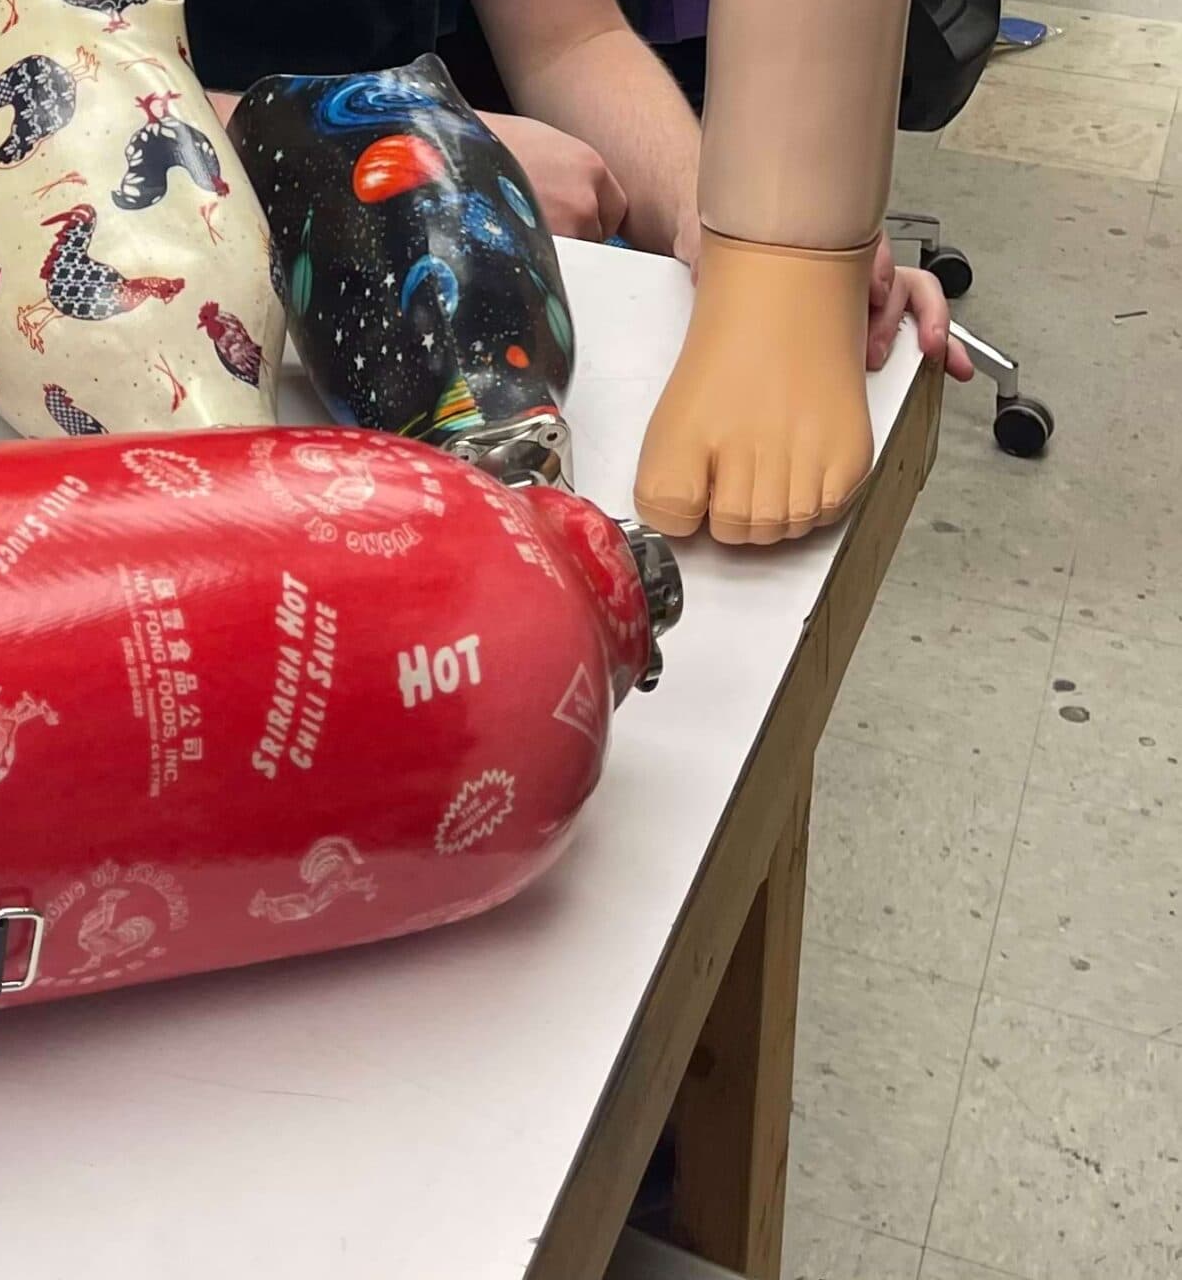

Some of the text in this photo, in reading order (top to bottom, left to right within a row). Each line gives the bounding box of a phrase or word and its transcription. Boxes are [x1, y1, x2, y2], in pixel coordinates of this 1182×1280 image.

[37, 475, 90, 519] CHILI
[134, 570, 153, 604] HUY
[143, 610, 167, 664] FONG
[397, 634, 481, 709] HOT
[156, 669, 178, 743] FOODS,
[252, 571, 308, 780] SRIRACHA HOT
[289, 601, 338, 770] CHILI SAUCE
